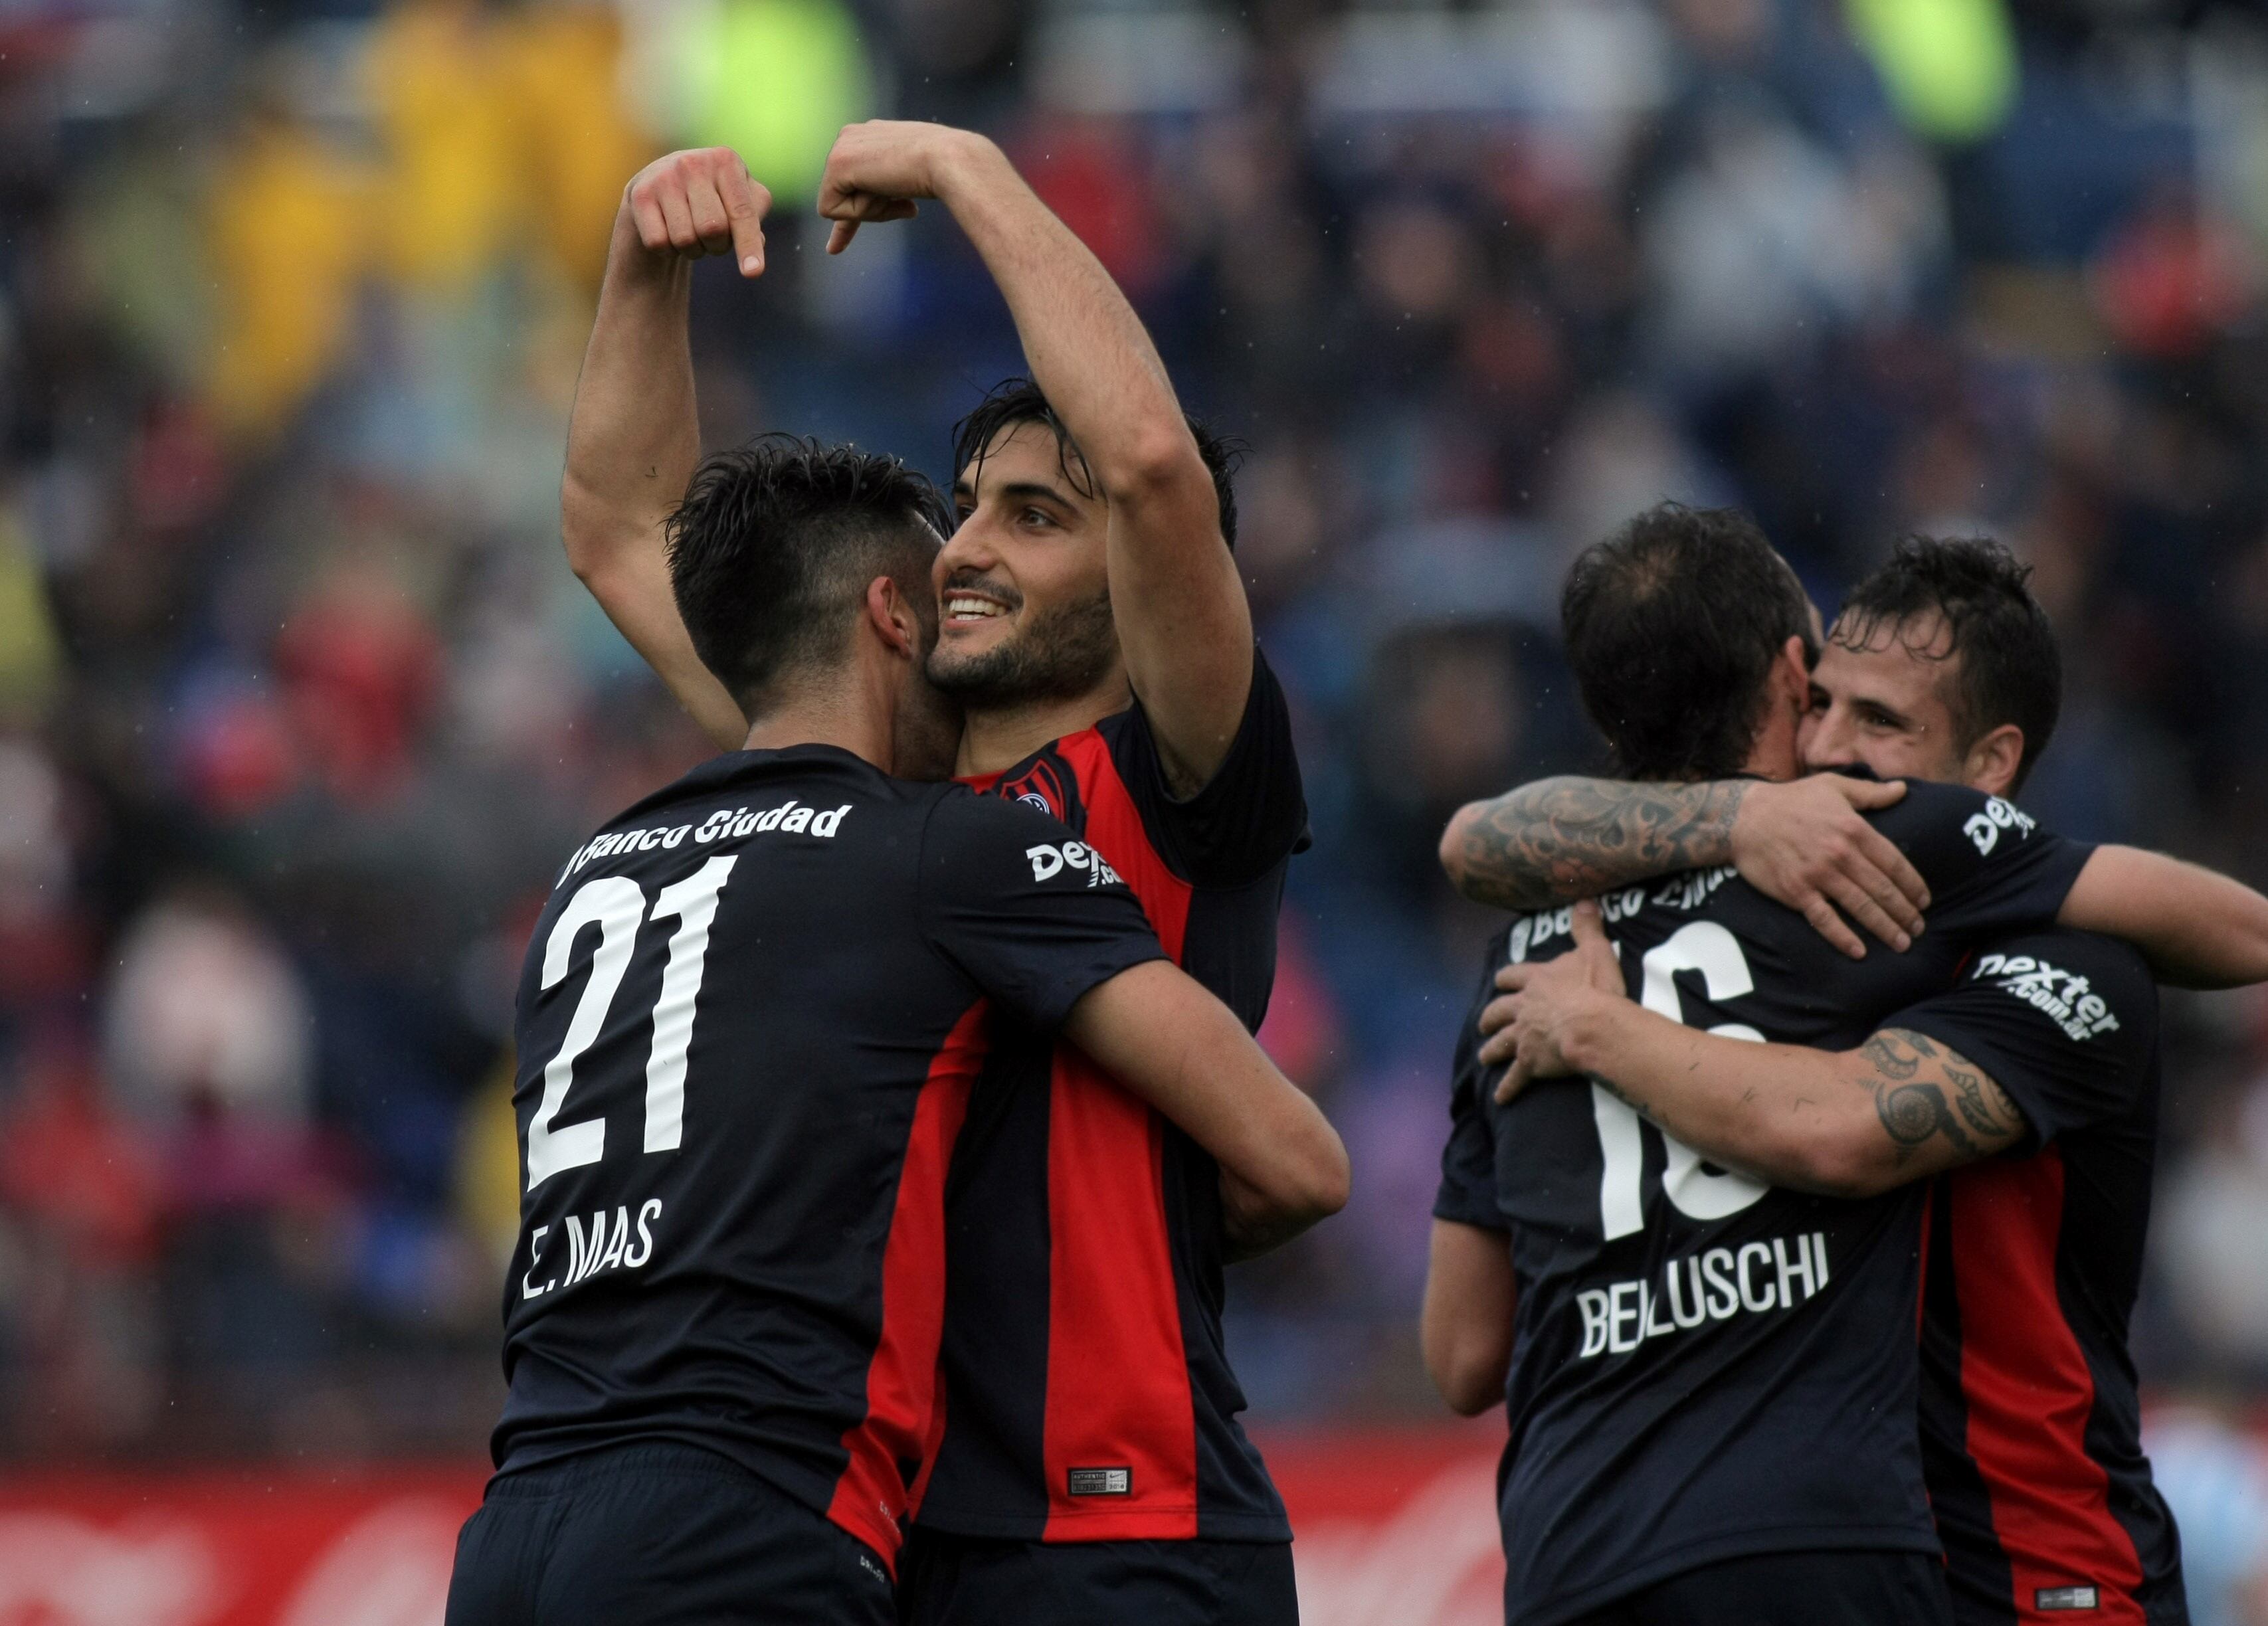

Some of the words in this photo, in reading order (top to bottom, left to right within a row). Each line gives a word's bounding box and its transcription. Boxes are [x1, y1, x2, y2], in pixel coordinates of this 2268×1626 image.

[573, 824, 693, 875] Banco
[694, 800, 853, 844] Ciudad
[527, 854, 739, 1194] 21
[1591, 921, 1772, 1241] 16
[523, 1225, 555, 1301] E.
[563, 1198, 663, 1287] MAS
